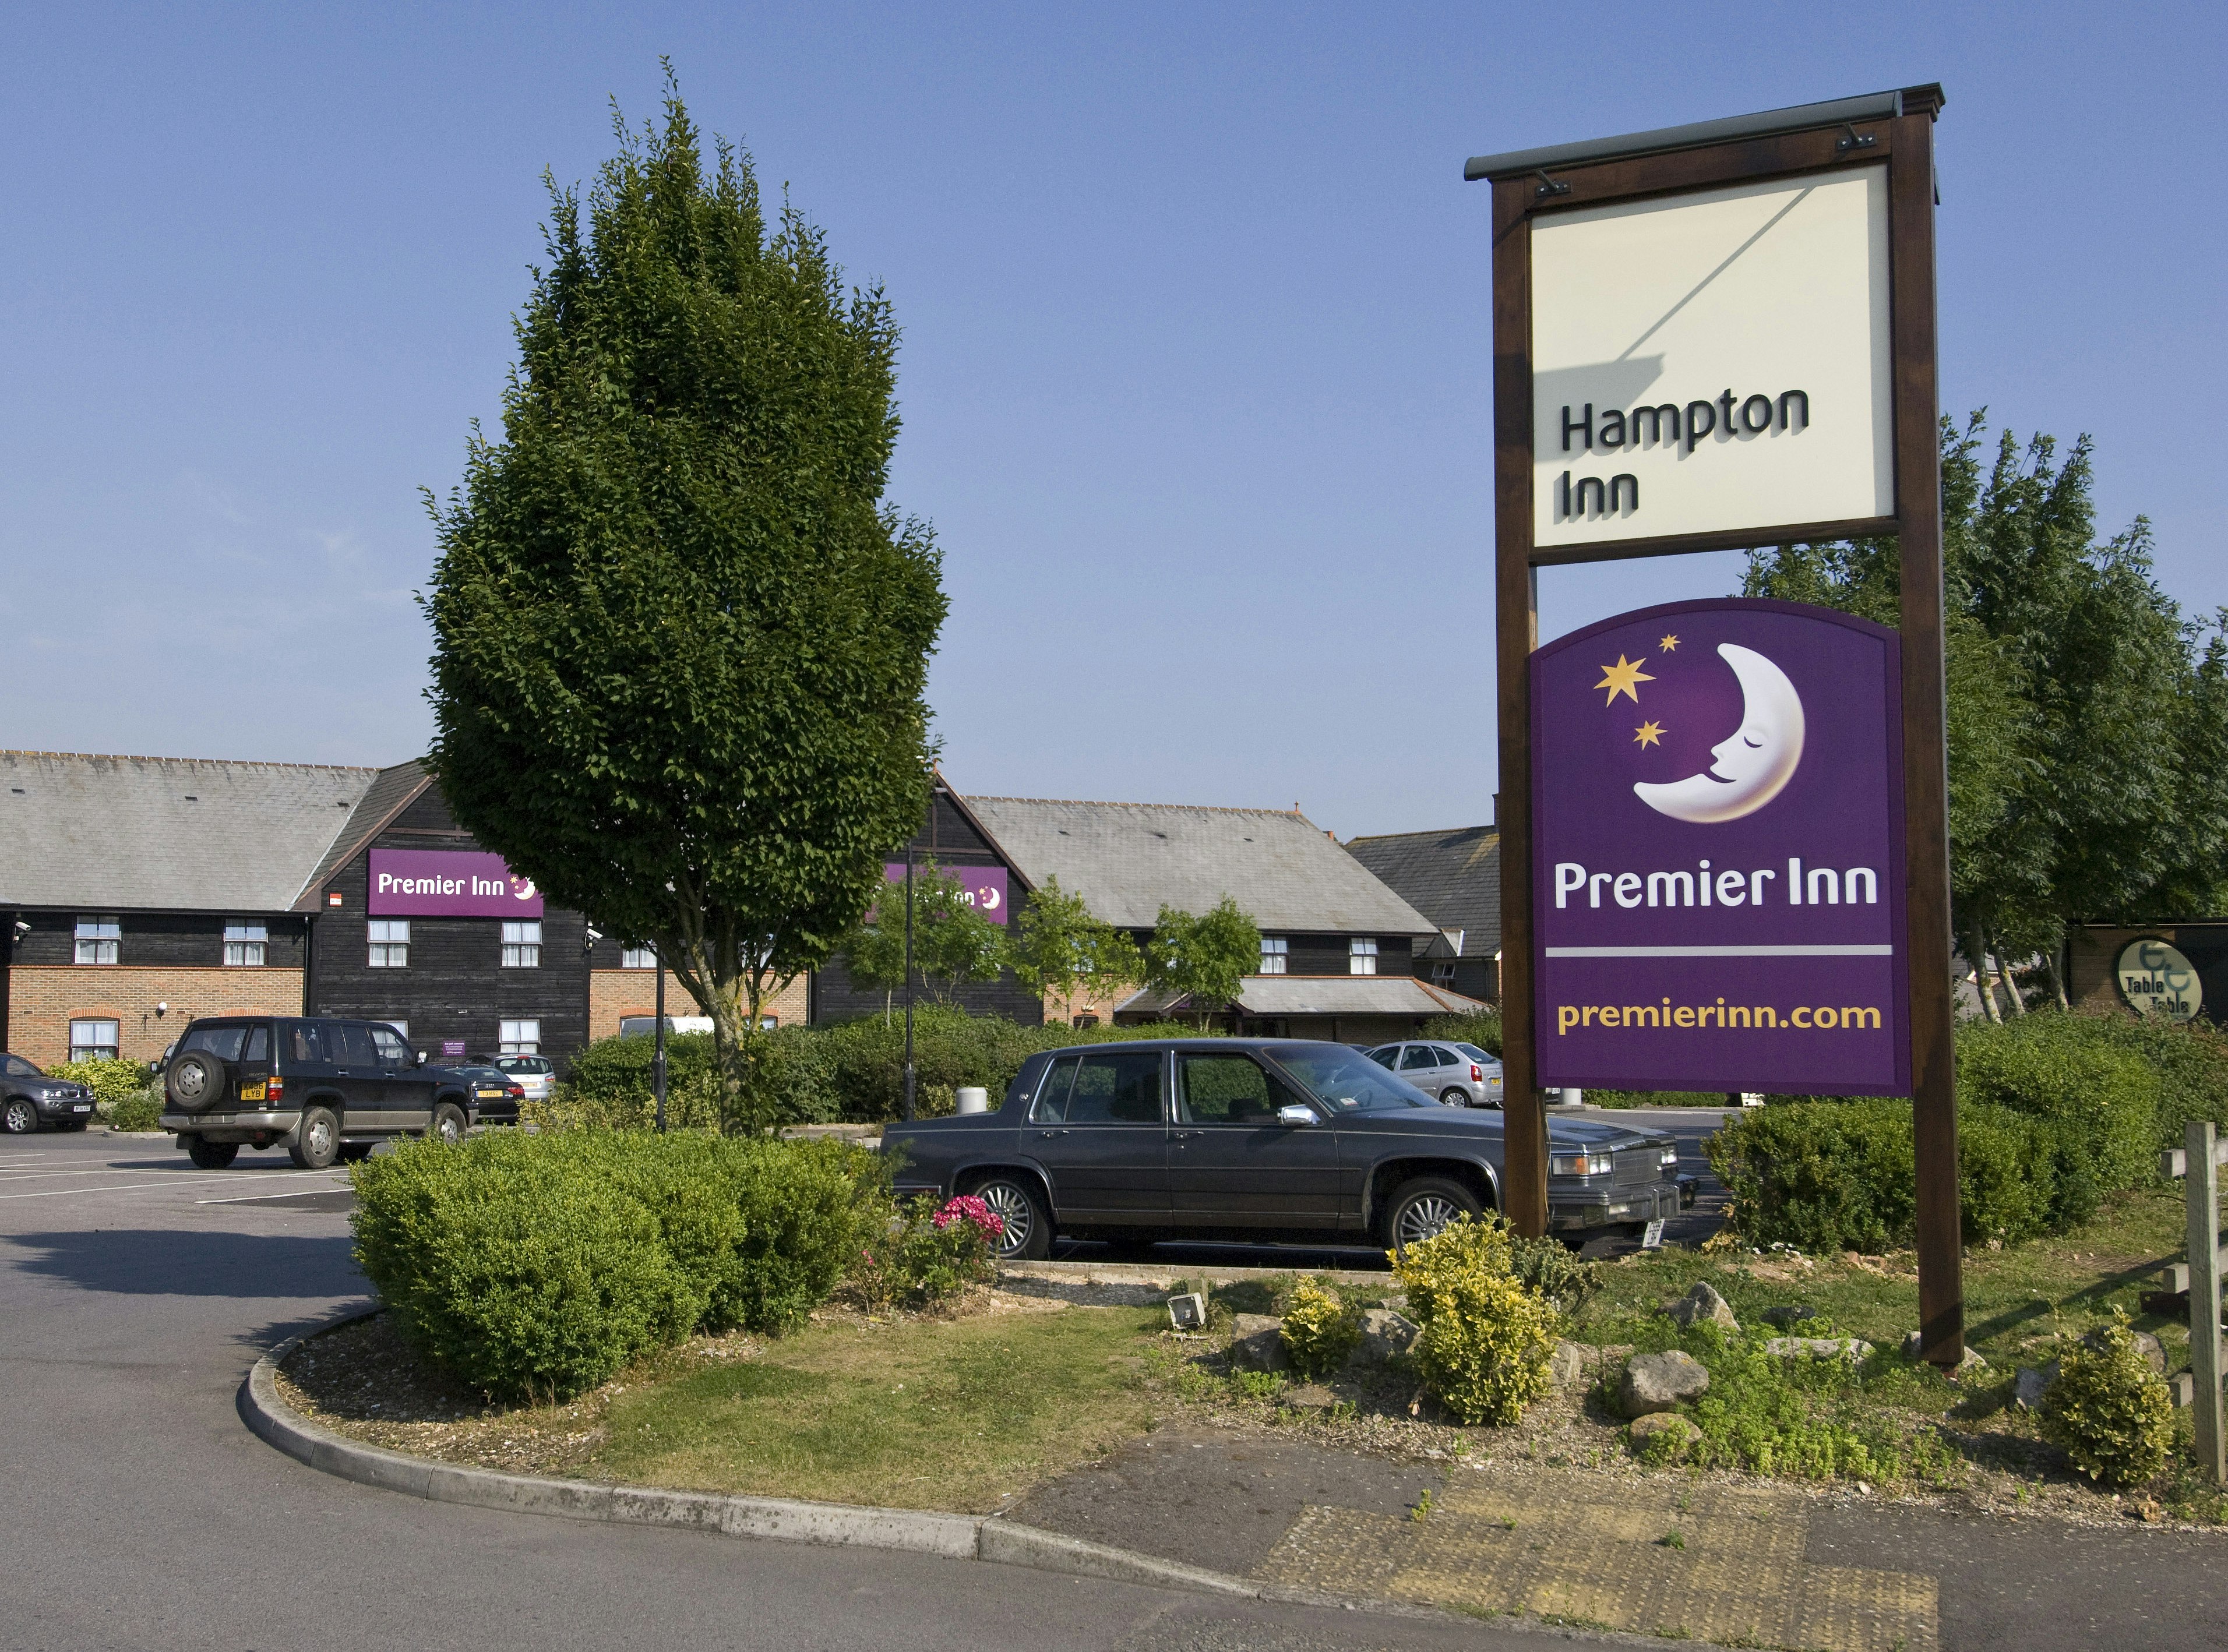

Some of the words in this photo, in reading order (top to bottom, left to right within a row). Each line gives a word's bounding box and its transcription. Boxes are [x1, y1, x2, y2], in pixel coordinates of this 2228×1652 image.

[1562, 388, 1809, 453] Hampton
[1563, 470, 1639, 516] Inn
[378, 873, 466, 895] Premier
[471, 875, 505, 896] Inn
[1554, 859, 1776, 909] Premier
[1788, 857, 1877, 905] Inn
[2125, 970, 2164, 993] Table
[1557, 997, 1881, 1036] premierinn.com
[245, 1090, 261, 1098] LYB
